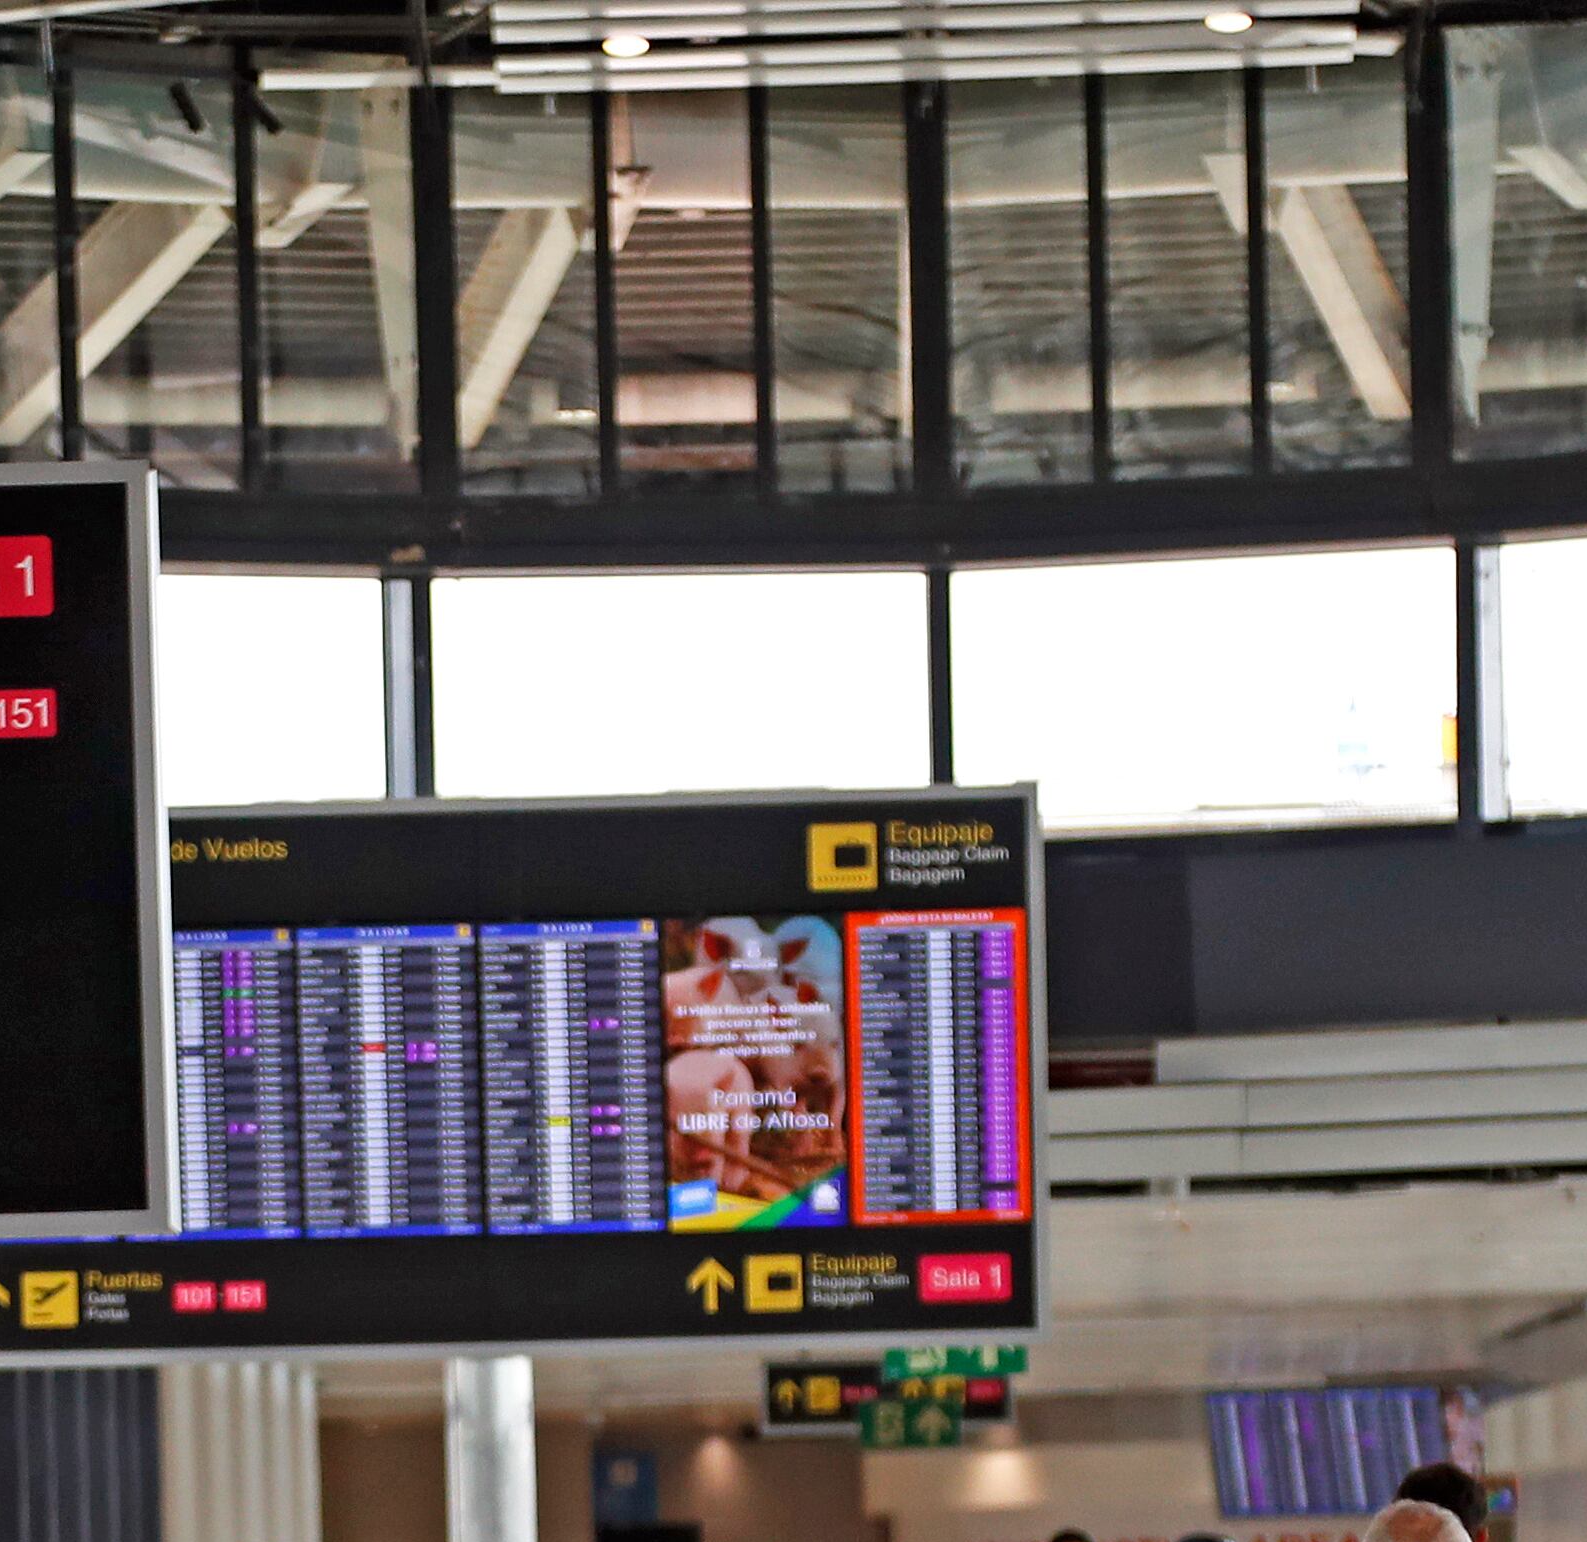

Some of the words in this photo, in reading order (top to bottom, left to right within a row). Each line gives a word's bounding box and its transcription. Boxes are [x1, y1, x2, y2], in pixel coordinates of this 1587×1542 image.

[15, 555, 34, 597] 1
[889, 821, 994, 847] Equipaje
[170, 839, 198, 861] de
[203, 838, 289, 861] Vuelos
[889, 848, 960, 866] Baggage
[965, 846, 1010, 861] Claim
[889, 867, 965, 885] Bagagem
[712, 1086, 796, 1106] Panamá
[680, 1111, 729, 1132] LIBRE
[735, 1112, 762, 1130] de
[811, 1253, 898, 1275] Equipaje
[87, 1271, 163, 1289] Puertas
[812, 1274, 871, 1290] Baggage
[873, 1273, 911, 1287] Claim
[932, 1268, 980, 1290] Sala
[989, 1265, 1003, 1288] 1
[812, 1289, 875, 1307] Bagagem
